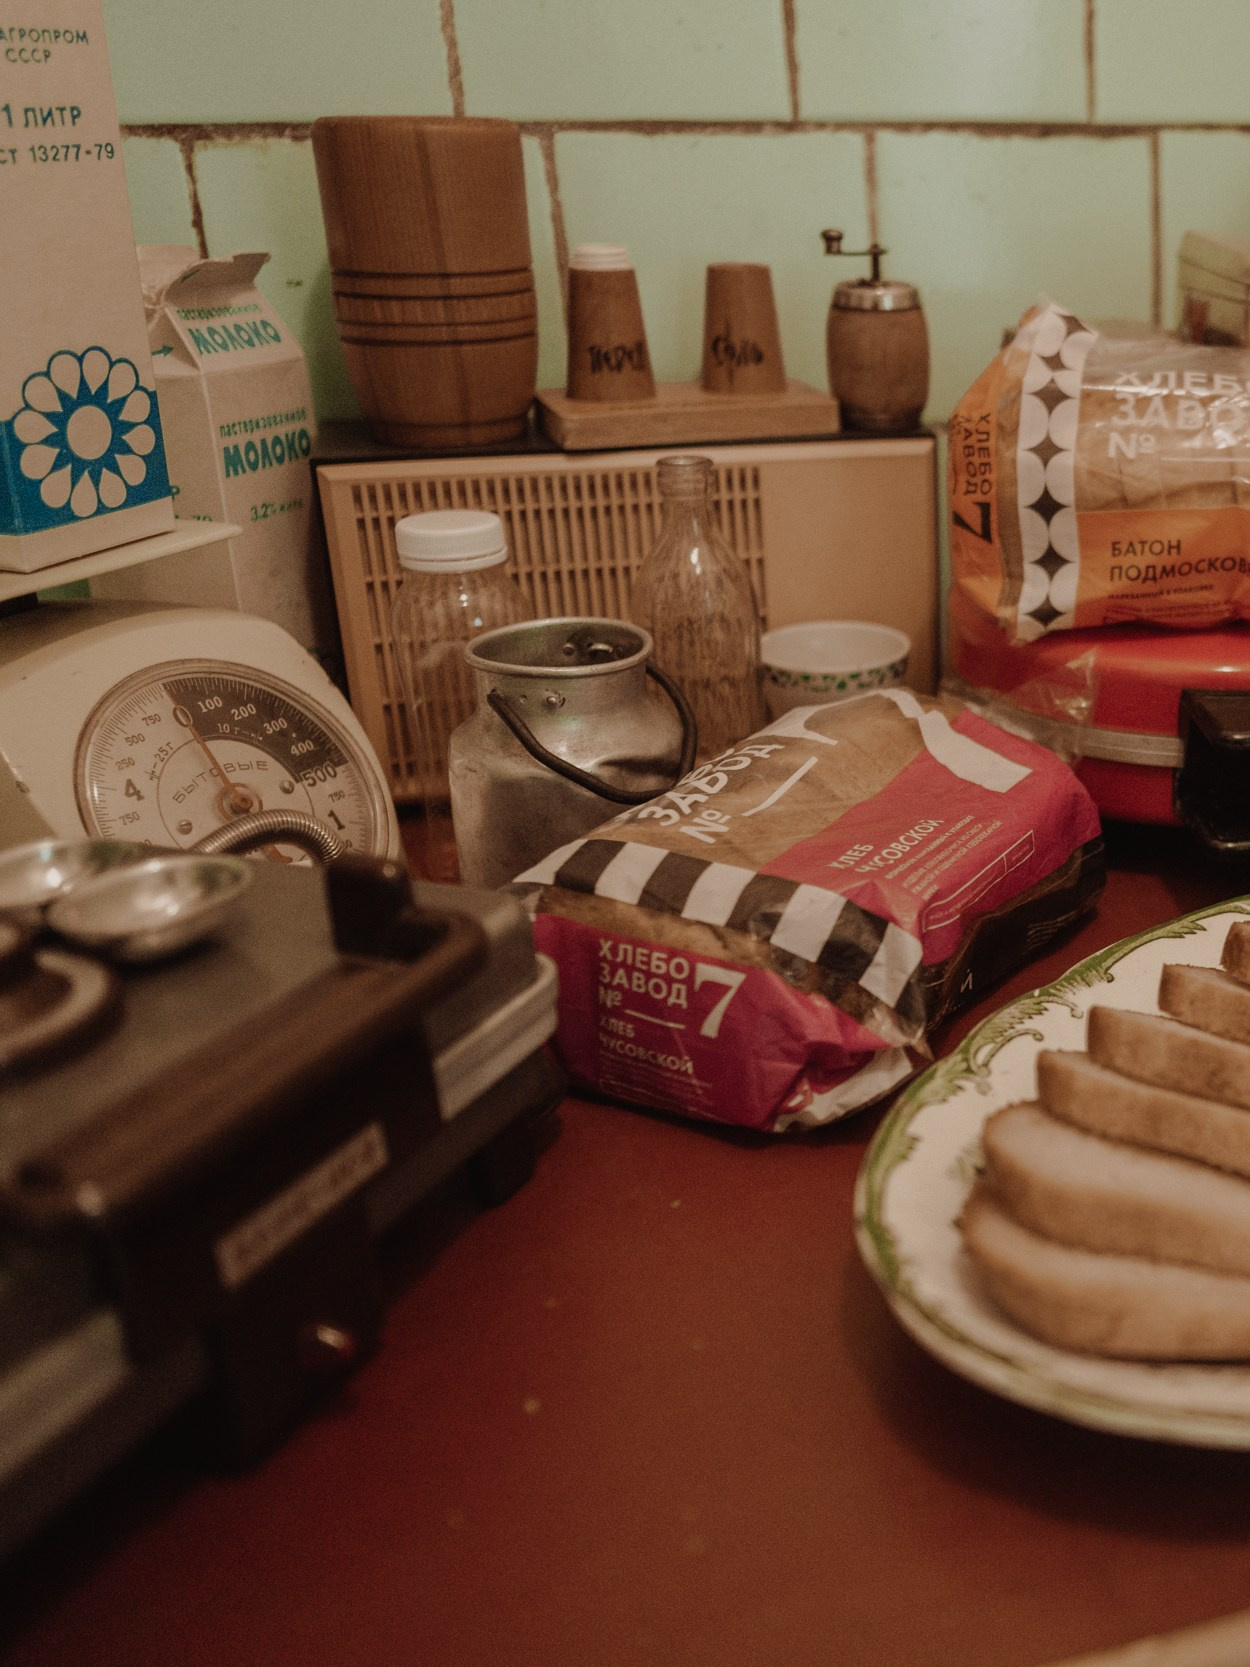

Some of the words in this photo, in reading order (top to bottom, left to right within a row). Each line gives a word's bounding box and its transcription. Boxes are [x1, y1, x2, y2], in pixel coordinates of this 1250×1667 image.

[5, 48, 51, 63] СССР
[2, 103, 13, 128] 1
[23, 105, 82, 128] ЛИТР
[29, 142, 115, 164] 13277-79
[187, 319, 282, 355] МОЛОКО
[223, 427, 312, 479] МОЛОКО
[974, 412, 993, 496] ХЛЕБО
[1107, 431, 1156, 459] №
[951, 501, 994, 545] 7
[1110, 539, 1182, 557] БАТОН
[197, 695, 223, 713] 100
[230, 702, 257, 721] 200
[141, 713, 162, 727] 750
[217, 723, 230, 734] 10
[263, 717, 288, 735] 300
[124, 732, 146, 747] 500
[289, 738, 315, 757] 400
[114, 756, 136, 771] 250
[301, 761, 338, 788] 500
[124, 777, 145, 801] 4
[117, 811, 141, 826] 750
[327, 809, 346, 831] 1
[679, 808, 733, 845] №
[822, 843, 875, 870] ХЛЕБ
[598, 937, 691, 981] ХЛЕБО
[599, 961, 689, 1010] ЗАВОД
[693, 961, 748, 1040] 7
